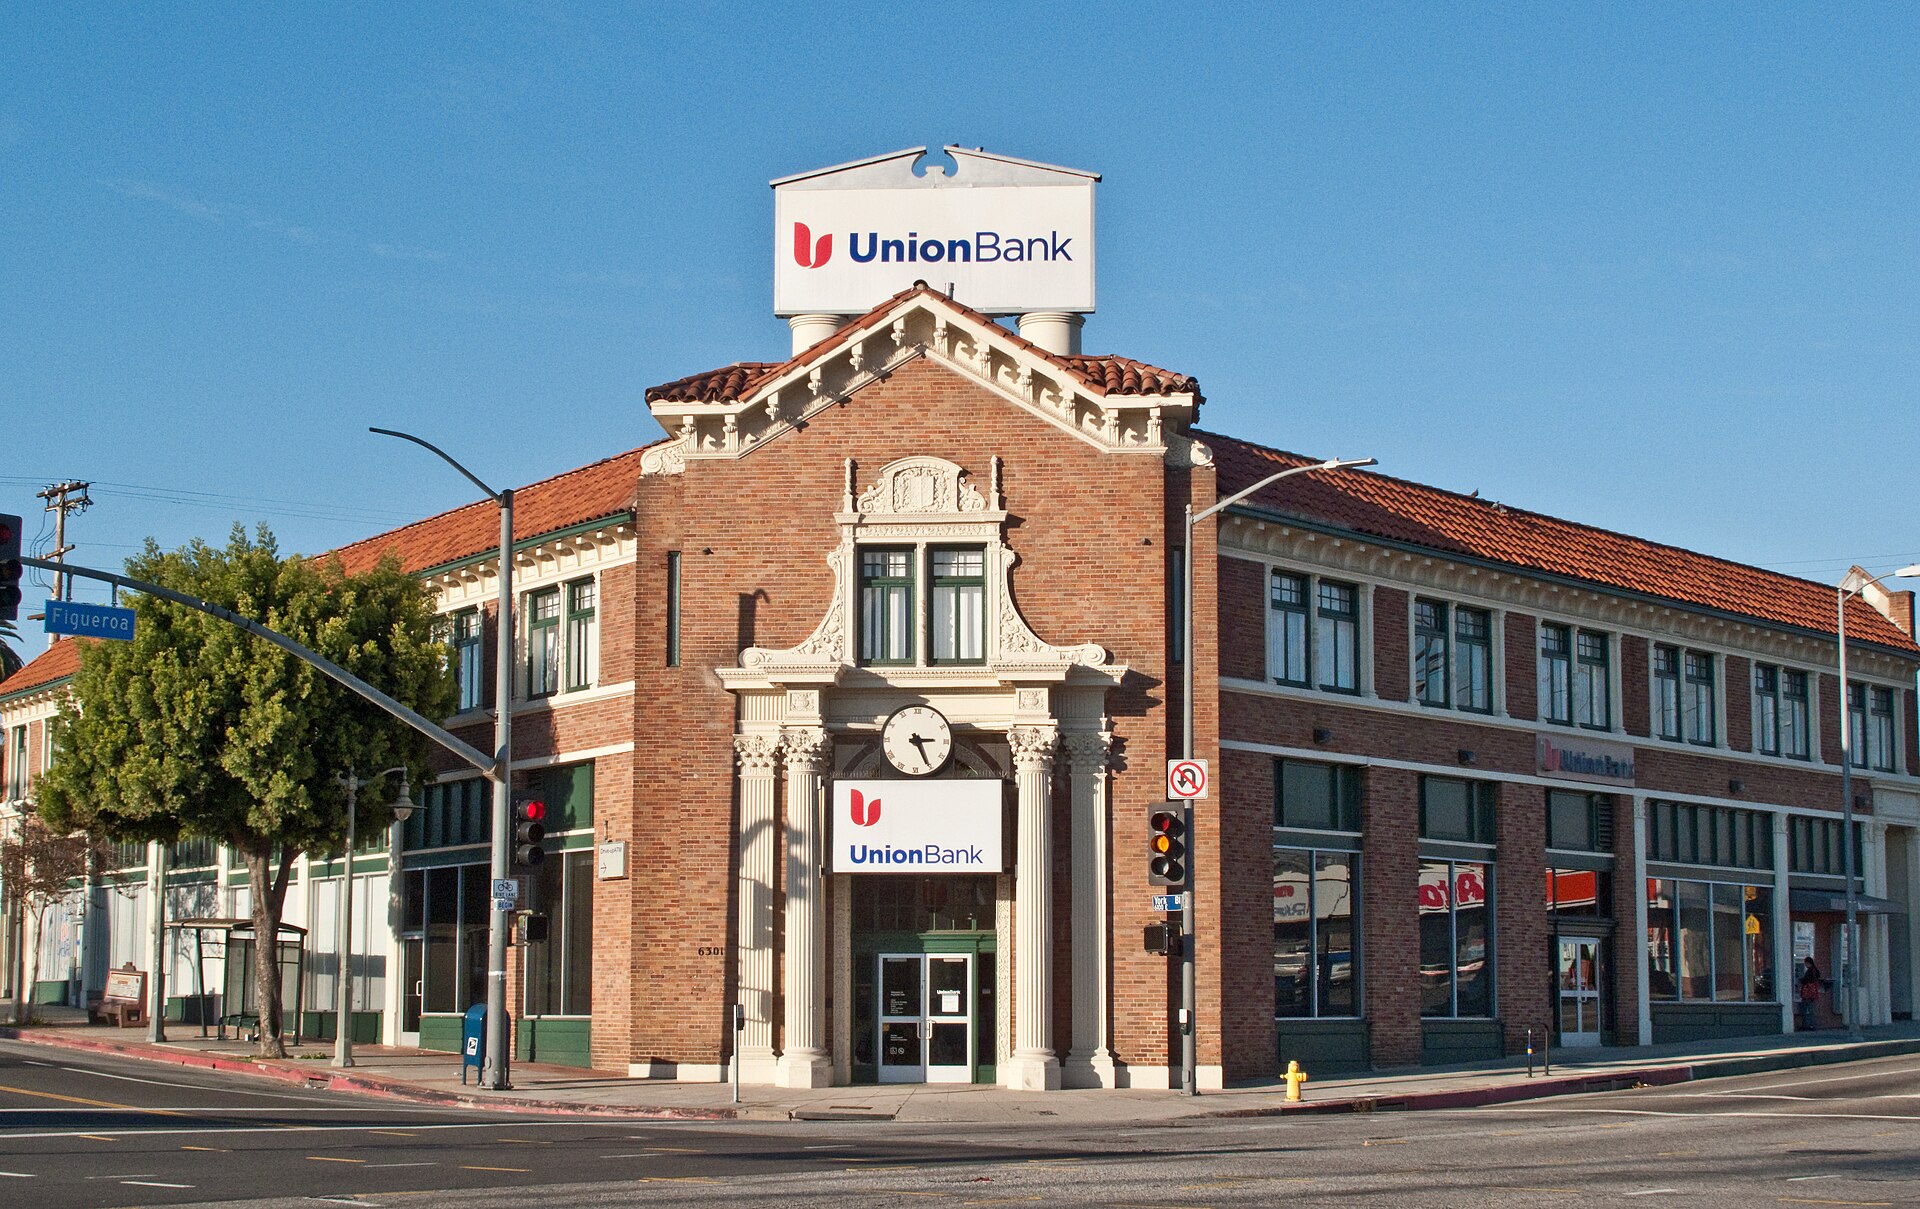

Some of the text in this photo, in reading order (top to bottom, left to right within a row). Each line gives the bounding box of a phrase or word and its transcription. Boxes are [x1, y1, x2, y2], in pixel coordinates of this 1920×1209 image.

[849, 231, 1073, 263] UnionBank
[52, 608, 129, 631] Figueroa
[850, 845, 983, 864] UnionBank
[1154, 896, 1168, 904] York
[698, 947, 723, 956] 6301
